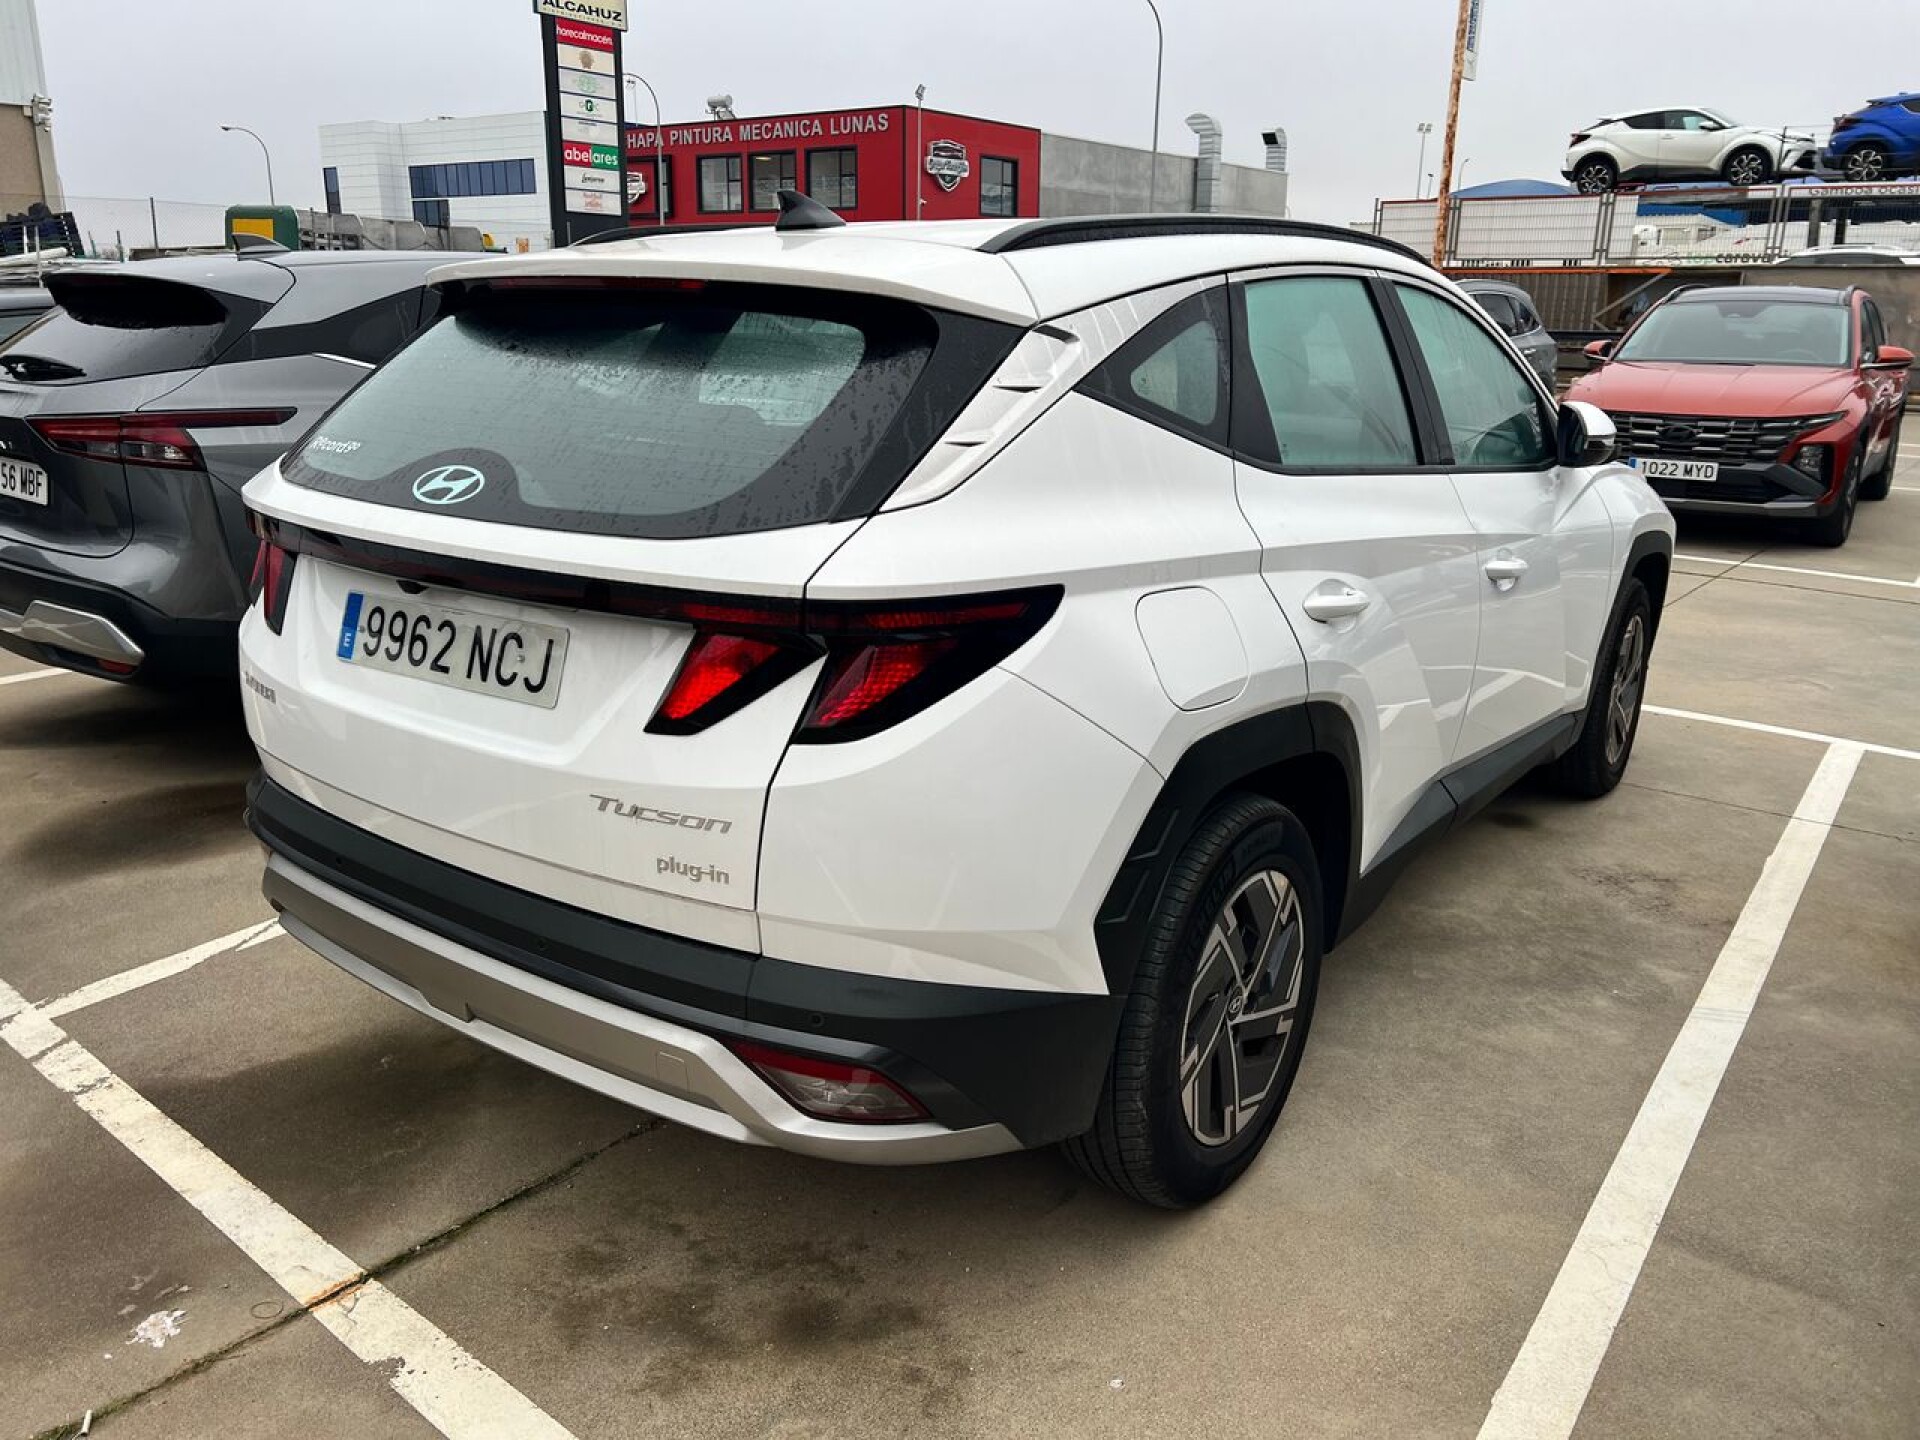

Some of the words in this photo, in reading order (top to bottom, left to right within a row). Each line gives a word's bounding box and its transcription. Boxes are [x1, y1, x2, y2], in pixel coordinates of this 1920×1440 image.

[543, 0, 622, 21] ALCAHUZ
[669, 125, 733, 146] PINTURA
[739, 119, 823, 142] MECANICA
[830, 113, 889, 135] LUNAS
[564, 146, 619, 166] abelares
[1641, 460, 1679, 476] 1022
[20, 465, 43, 498] MBF
[343, 632, 352, 647] E
[362, 605, 457, 674] 9962
[465, 624, 554, 694] NCJ
[656, 855, 730, 885] plug-in
